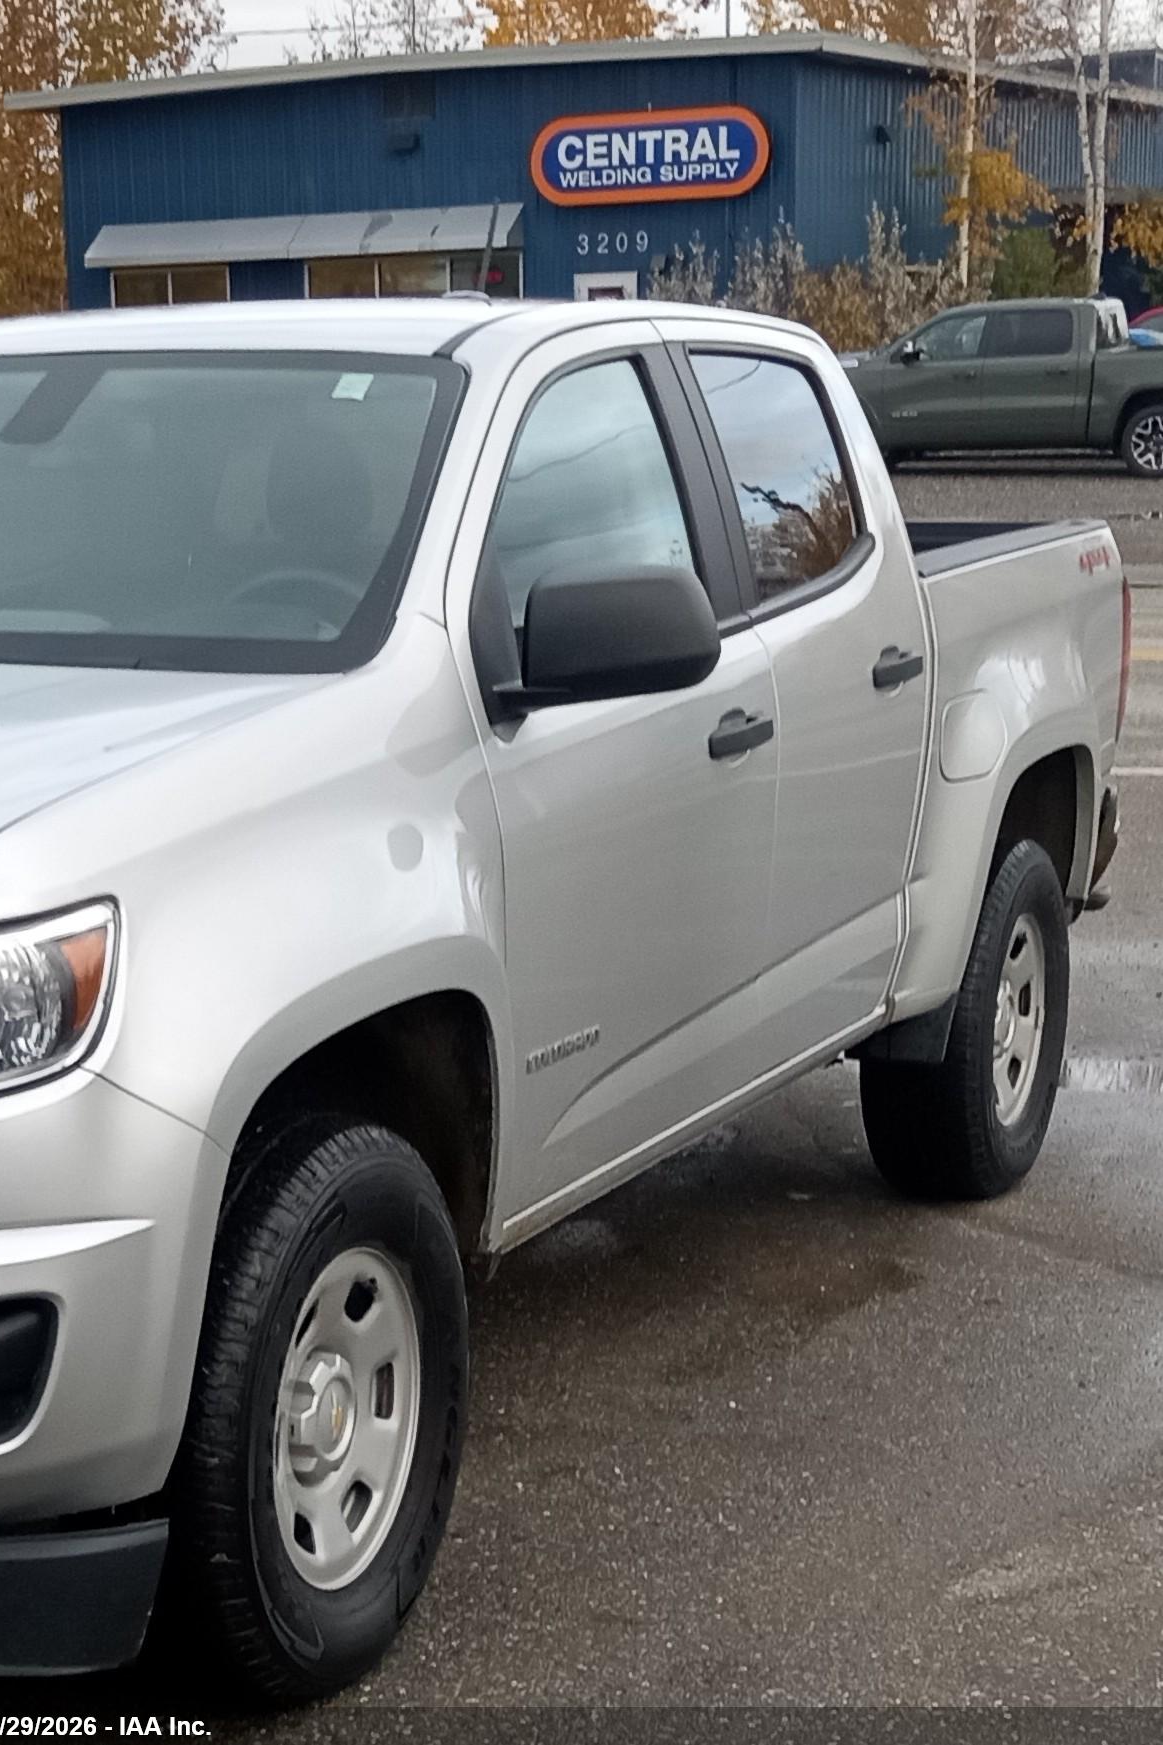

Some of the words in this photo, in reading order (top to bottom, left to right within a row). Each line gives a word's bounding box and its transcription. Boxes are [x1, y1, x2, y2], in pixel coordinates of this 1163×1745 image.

[558, 126, 740, 169] CENTRAL
[560, 169, 652, 188] WELDING
[659, 162, 739, 182] SUPPLY
[577, 231, 648, 256] 3209
